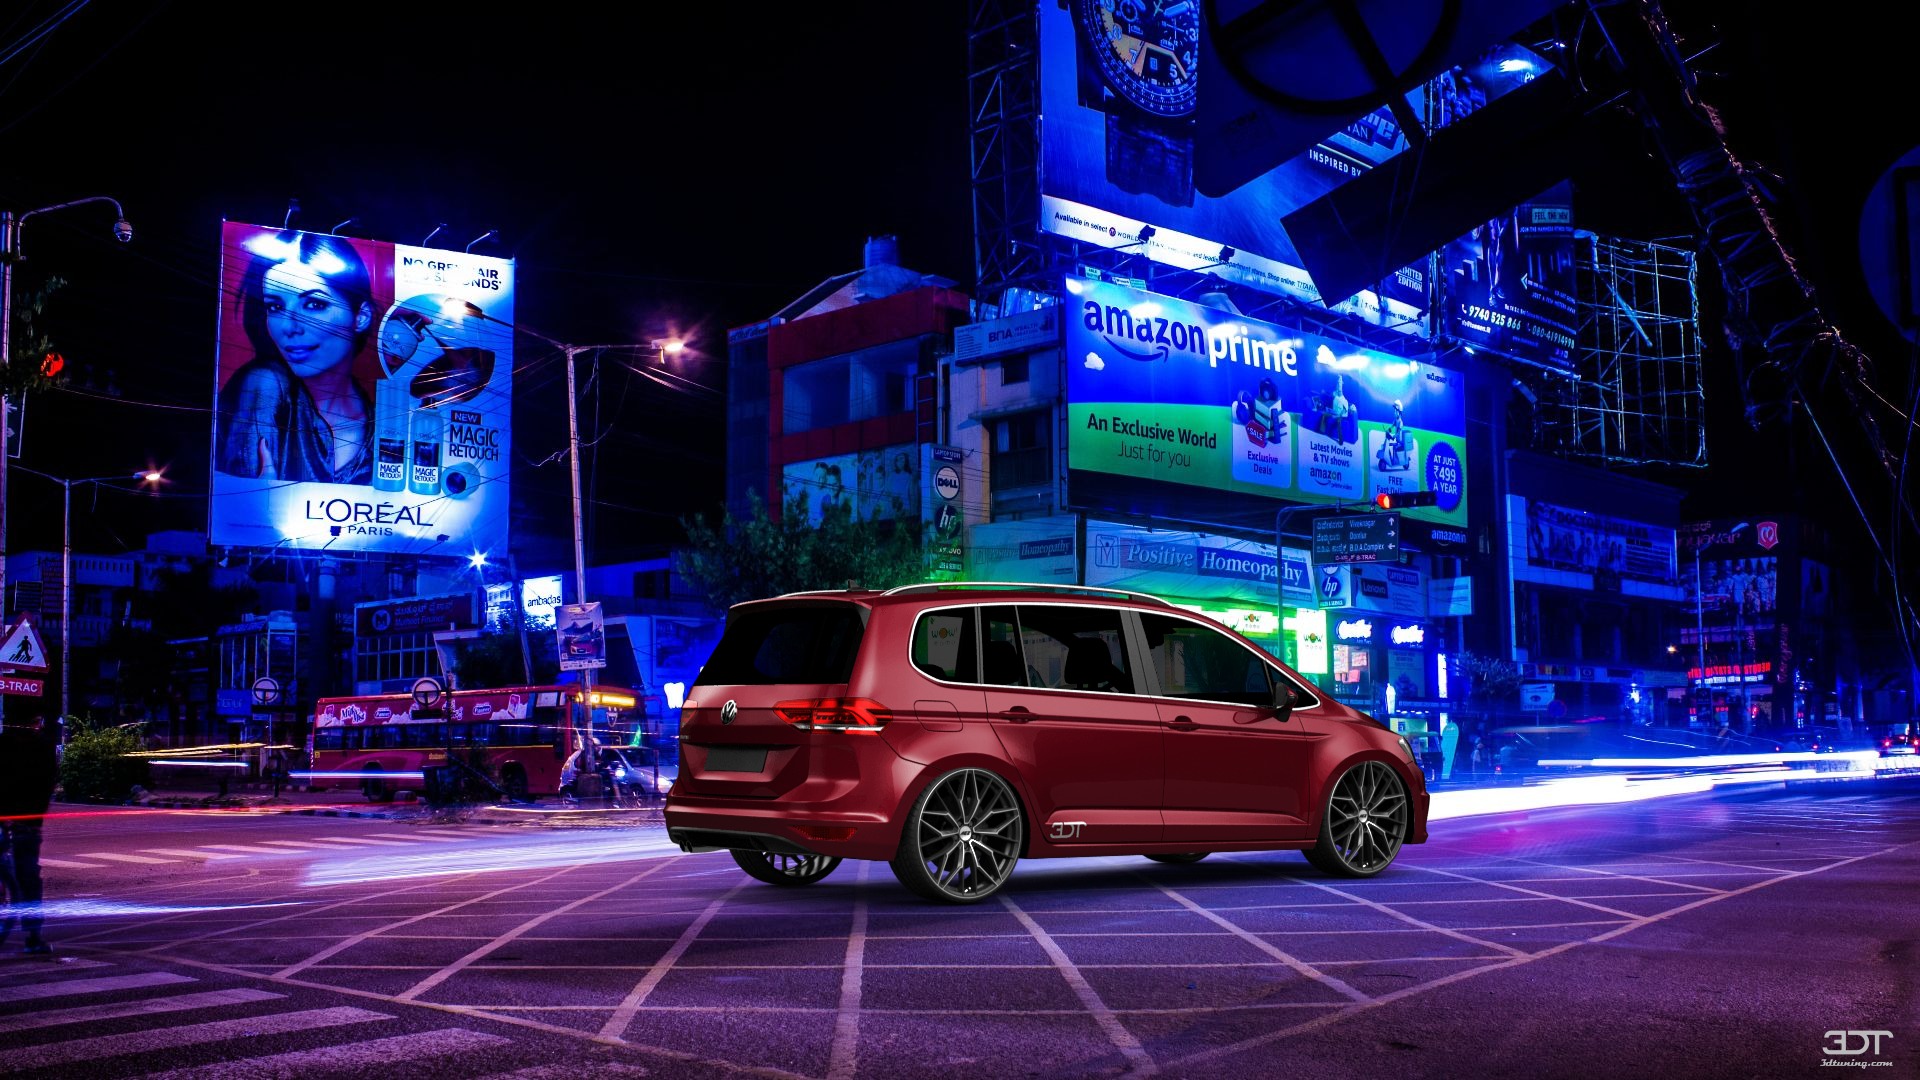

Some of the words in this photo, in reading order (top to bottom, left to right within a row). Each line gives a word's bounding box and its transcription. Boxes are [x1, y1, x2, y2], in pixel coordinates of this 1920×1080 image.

[1309, 149, 1349, 173] INSPIRED
[1351, 167, 1362, 177] BY
[1055, 211, 1083, 226] Available
[1083, 219, 1090, 228] in
[1090, 223, 1108, 233] select
[1267, 272, 1281, 283] Shop
[1468, 305, 1490, 321] 9740
[1490, 311, 1506, 327] 525
[1083, 300, 1206, 356] amazon
[1206, 325, 1298, 377] prime
[454, 412, 478, 423] NEW
[448, 424, 499, 448] MAGIC
[1087, 413, 1108, 432] An
[1112, 416, 1175, 443] Exclusive
[1178, 427, 1217, 450] World
[1249, 427, 1263, 441] SALE
[448, 443, 499, 462] RETOUCH
[1118, 440, 1144, 459] Just
[1147, 444, 1164, 463] for
[1167, 451, 1191, 469] you
[1310, 441, 1330, 453] Latest
[1330, 446, 1353, 458] Movies
[1247, 450, 1279, 465] Exclusive
[1313, 453, 1319, 462] &
[1320, 454, 1329, 464] TV
[1330, 456, 1350, 468] shows
[1433, 455, 1441, 463] AT
[1442, 458, 1456, 467] JUST
[379, 463, 401, 473] MAGIC
[379, 471, 402, 479] RETOUCH
[415, 466, 436, 477] MAGIC
[1253, 463, 1273, 476] Deals
[1310, 466, 1342, 482] amazon
[1433, 466, 1457, 483] ₹499
[414, 474, 437, 483] RETOUCH
[937, 477, 958, 489] DELL
[1388, 475, 1403, 486] FREE
[1433, 482, 1439, 491] A
[1440, 484, 1457, 495] YEAR
[347, 525, 393, 537] PARIS
[1021, 540, 1071, 557] Homeopathy
[1127, 542, 1194, 568] Positive
[1324, 577, 1338, 598] hp
[528, 595, 561, 607] ambadas
